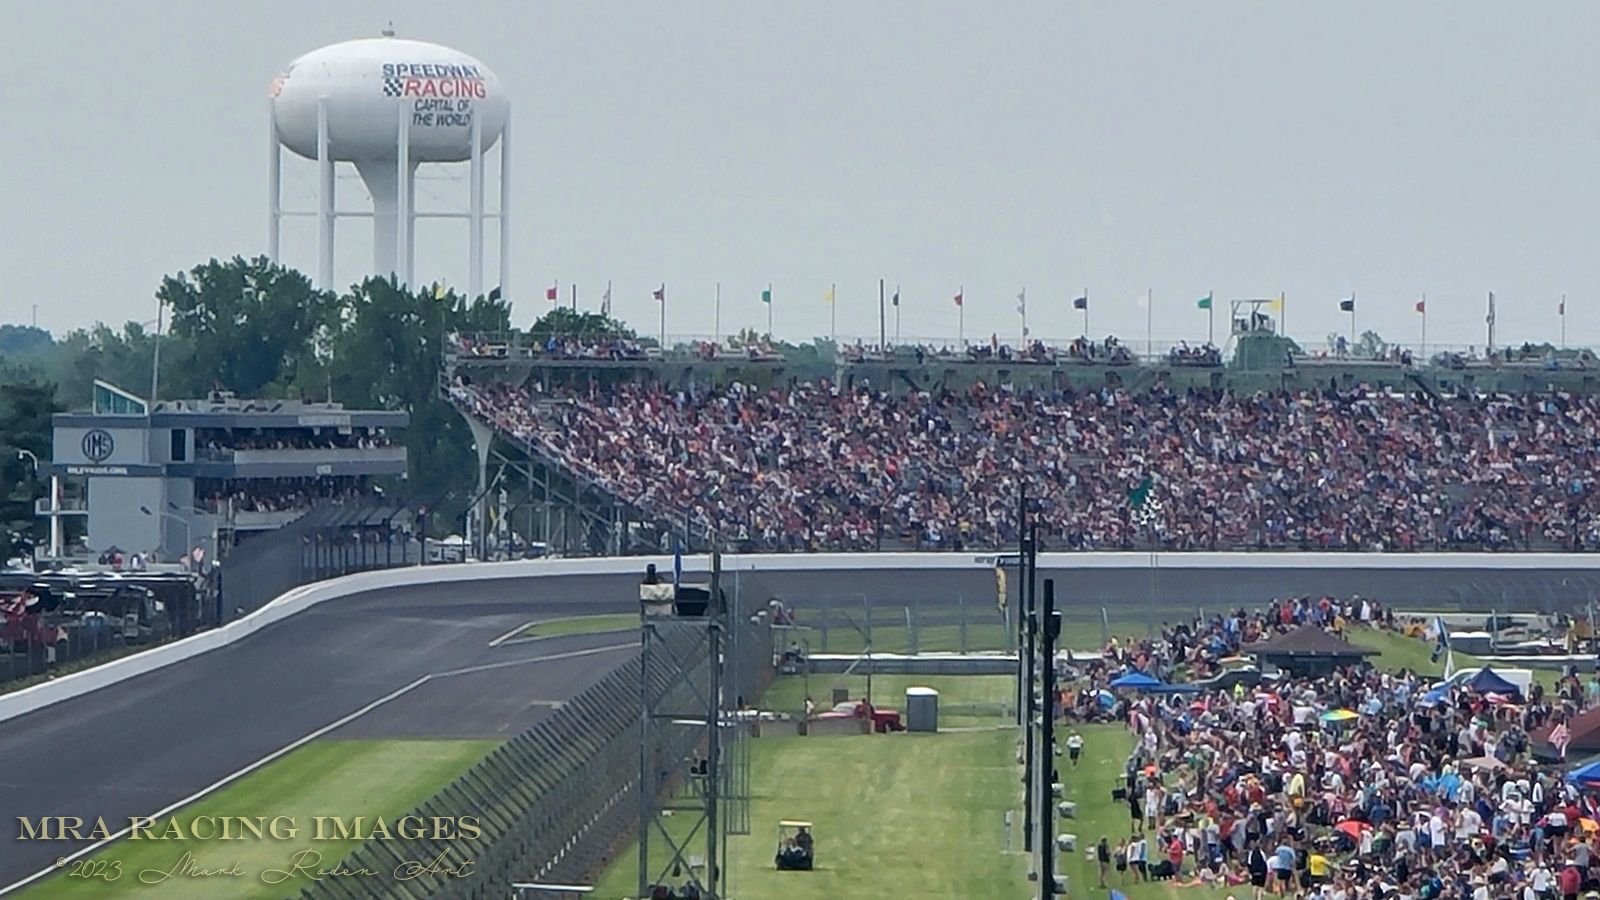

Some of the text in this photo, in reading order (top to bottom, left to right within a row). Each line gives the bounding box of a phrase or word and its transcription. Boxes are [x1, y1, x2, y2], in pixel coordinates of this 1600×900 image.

[404, 79, 486, 98] RACING
[414, 99, 453, 111] CAPITAL
[412, 112, 471, 126] THE WORLD
